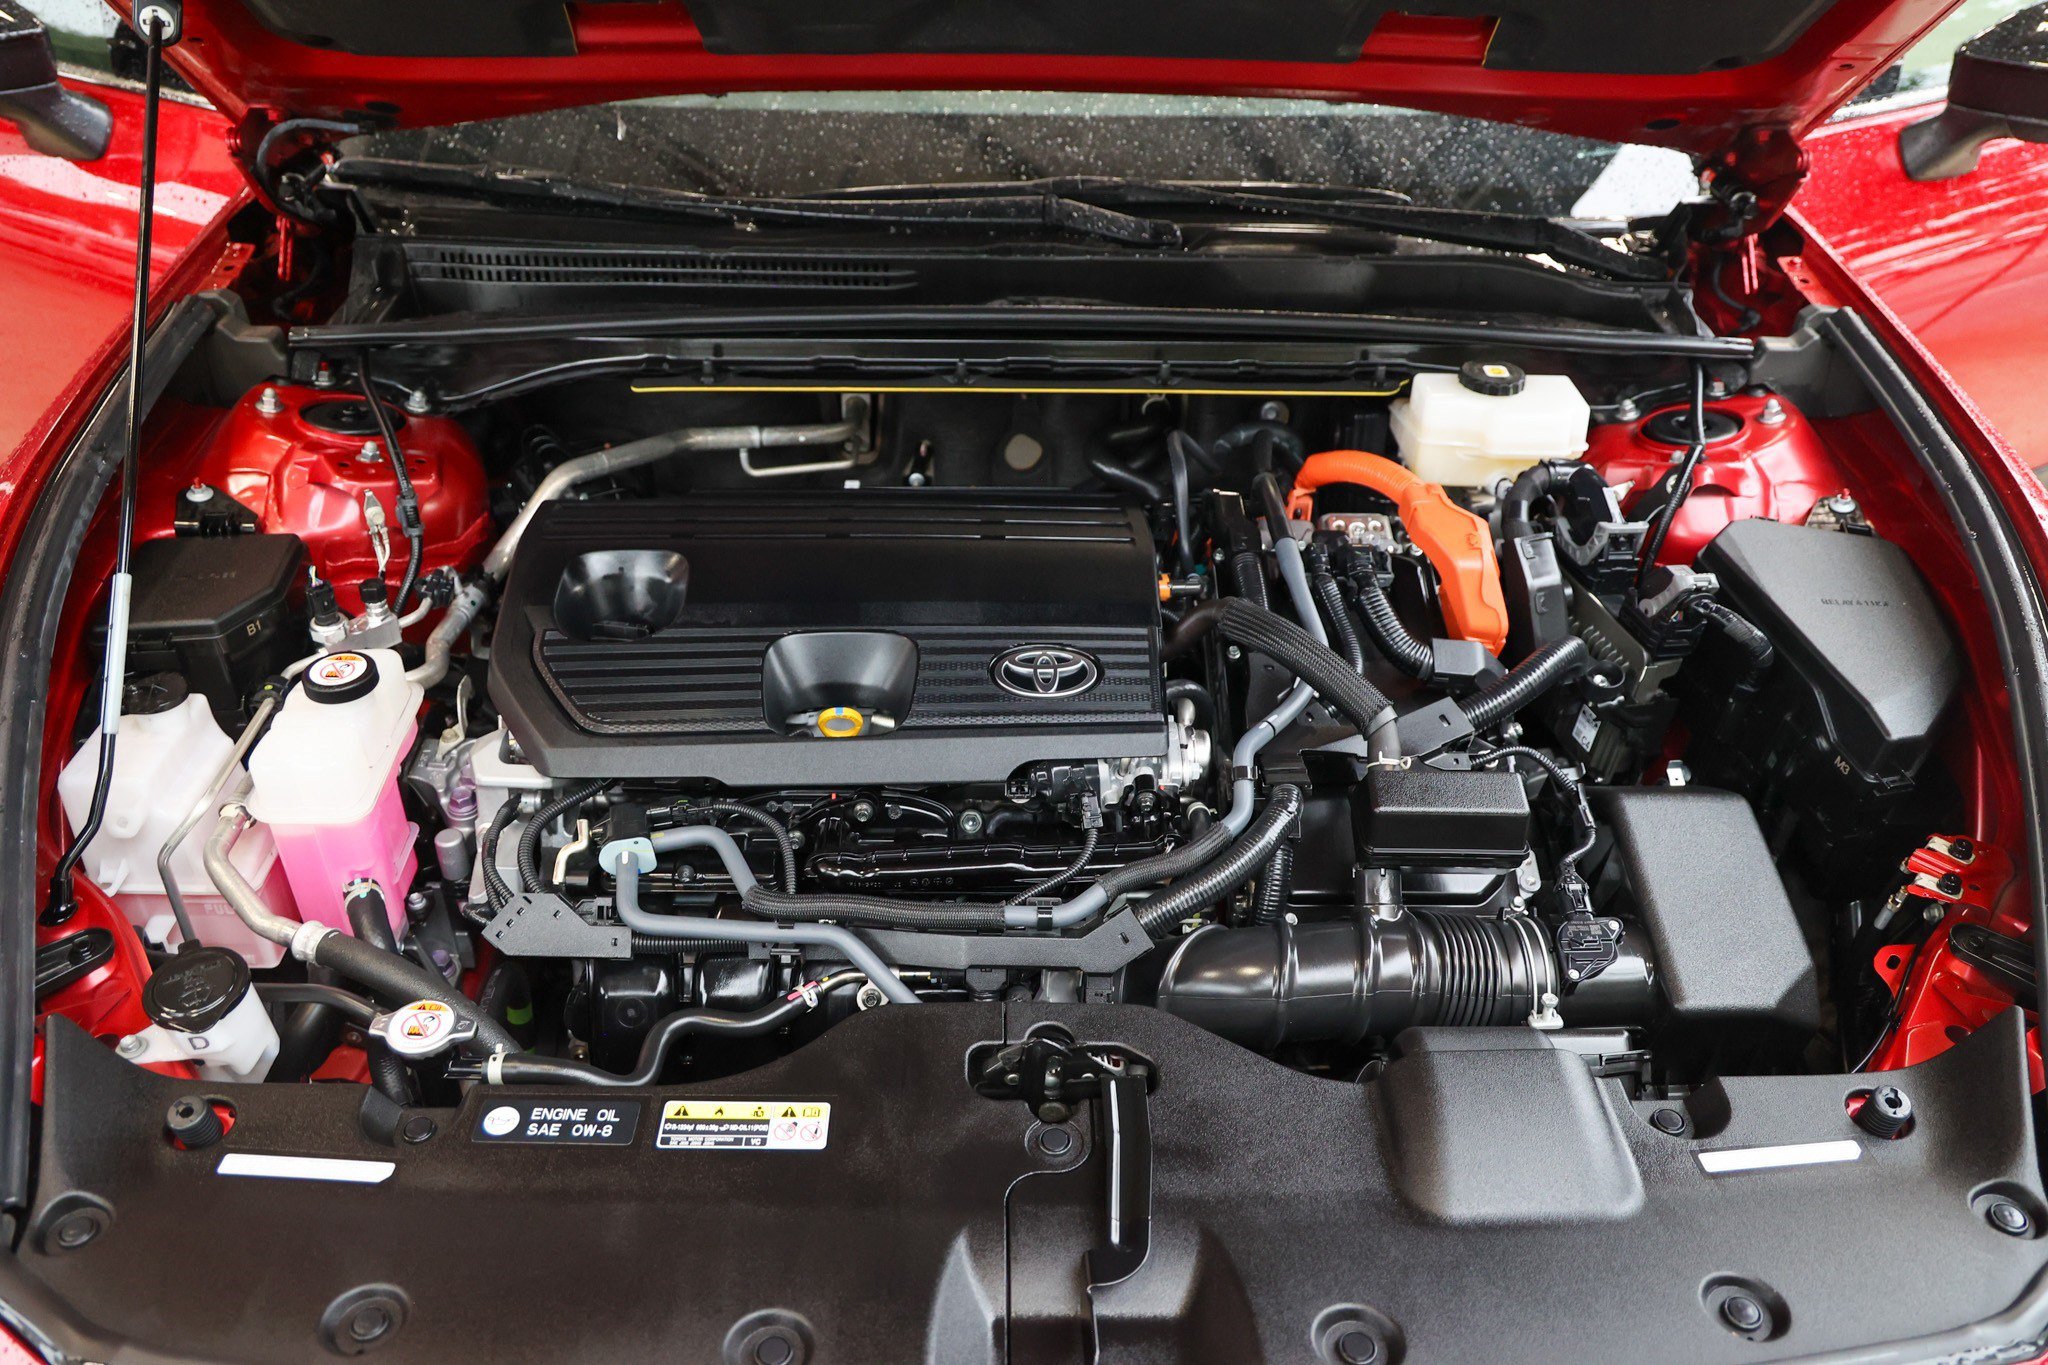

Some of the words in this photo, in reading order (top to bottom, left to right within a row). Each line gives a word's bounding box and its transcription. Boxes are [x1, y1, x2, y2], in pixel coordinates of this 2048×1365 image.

[246, 619, 262, 636] B1
[1834, 755, 1850, 775] M3
[187, 1036, 210, 1051] D
[530, 1107, 588, 1121] ENGINE
[596, 1109, 621, 1122] OIL
[526, 1123, 562, 1137] SAE
